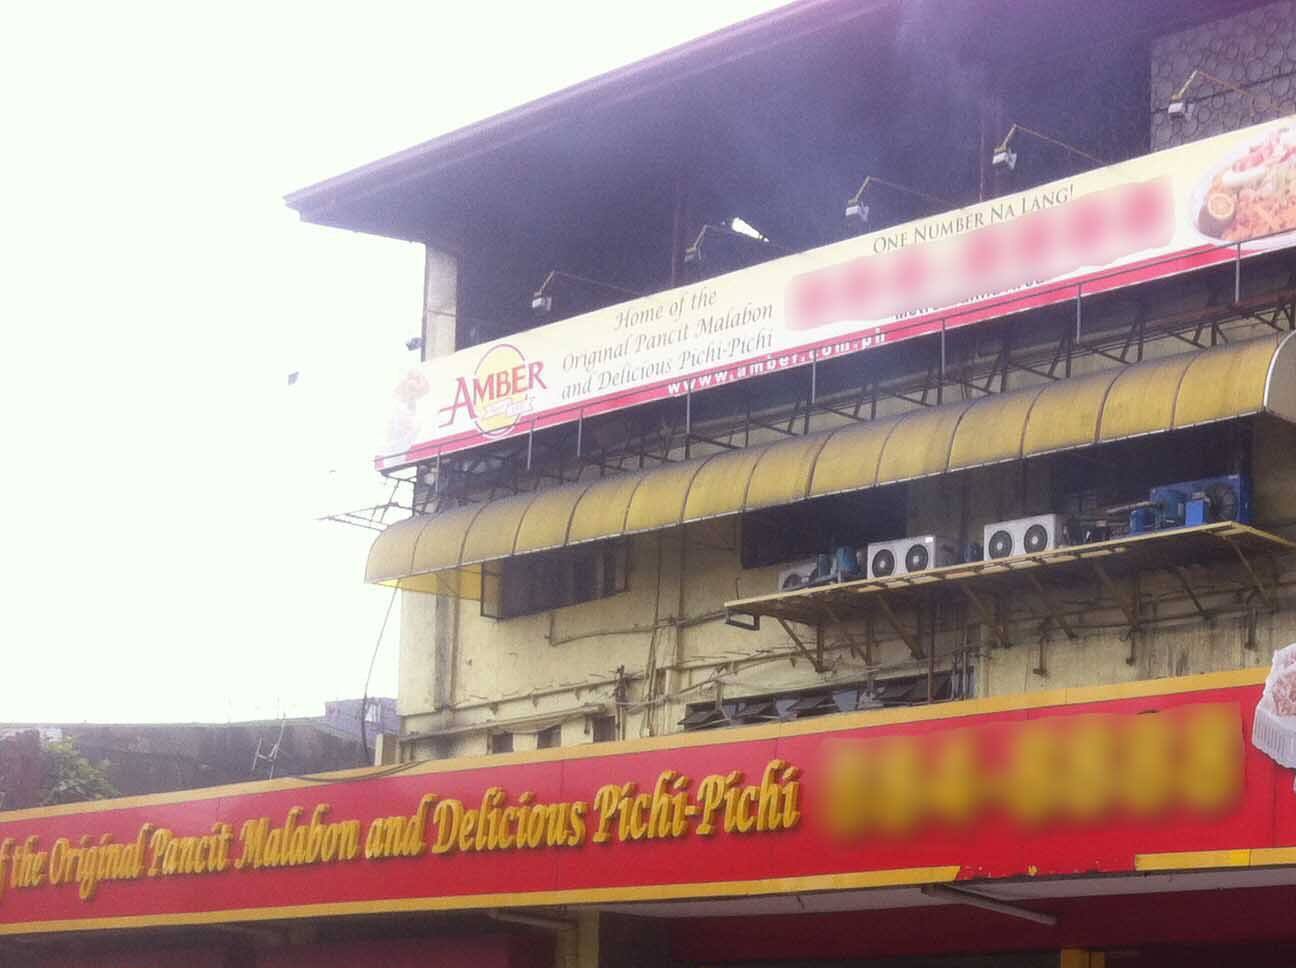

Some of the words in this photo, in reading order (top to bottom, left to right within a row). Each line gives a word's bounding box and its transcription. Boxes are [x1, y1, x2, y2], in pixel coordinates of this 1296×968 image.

[914, 211, 985, 243] NUMBER
[990, 203, 1015, 225] NA
[1021, 184, 1075, 214] LANG!
[562, 333, 634, 373] Original
[636, 323, 689, 354] Pancit
[693, 301, 774, 338] Malabon
[614, 306, 667, 331] Home
[668, 297, 686, 319] of
[691, 286, 718, 310] the
[438, 360, 548, 429] AMBER
[561, 375, 593, 400] and
[598, 358, 672, 390] Delicious
[680, 328, 774, 370] Pichi-Pichi
[10, 834, 48, 888] the
[50, 821, 154, 901] Original
[147, 821, 234, 877] Pancit
[234, 803, 361, 869] Malabon
[365, 793, 438, 859] and
[432, 785, 588, 854] Delicious
[592, 758, 801, 843] Pichi-Pichi
